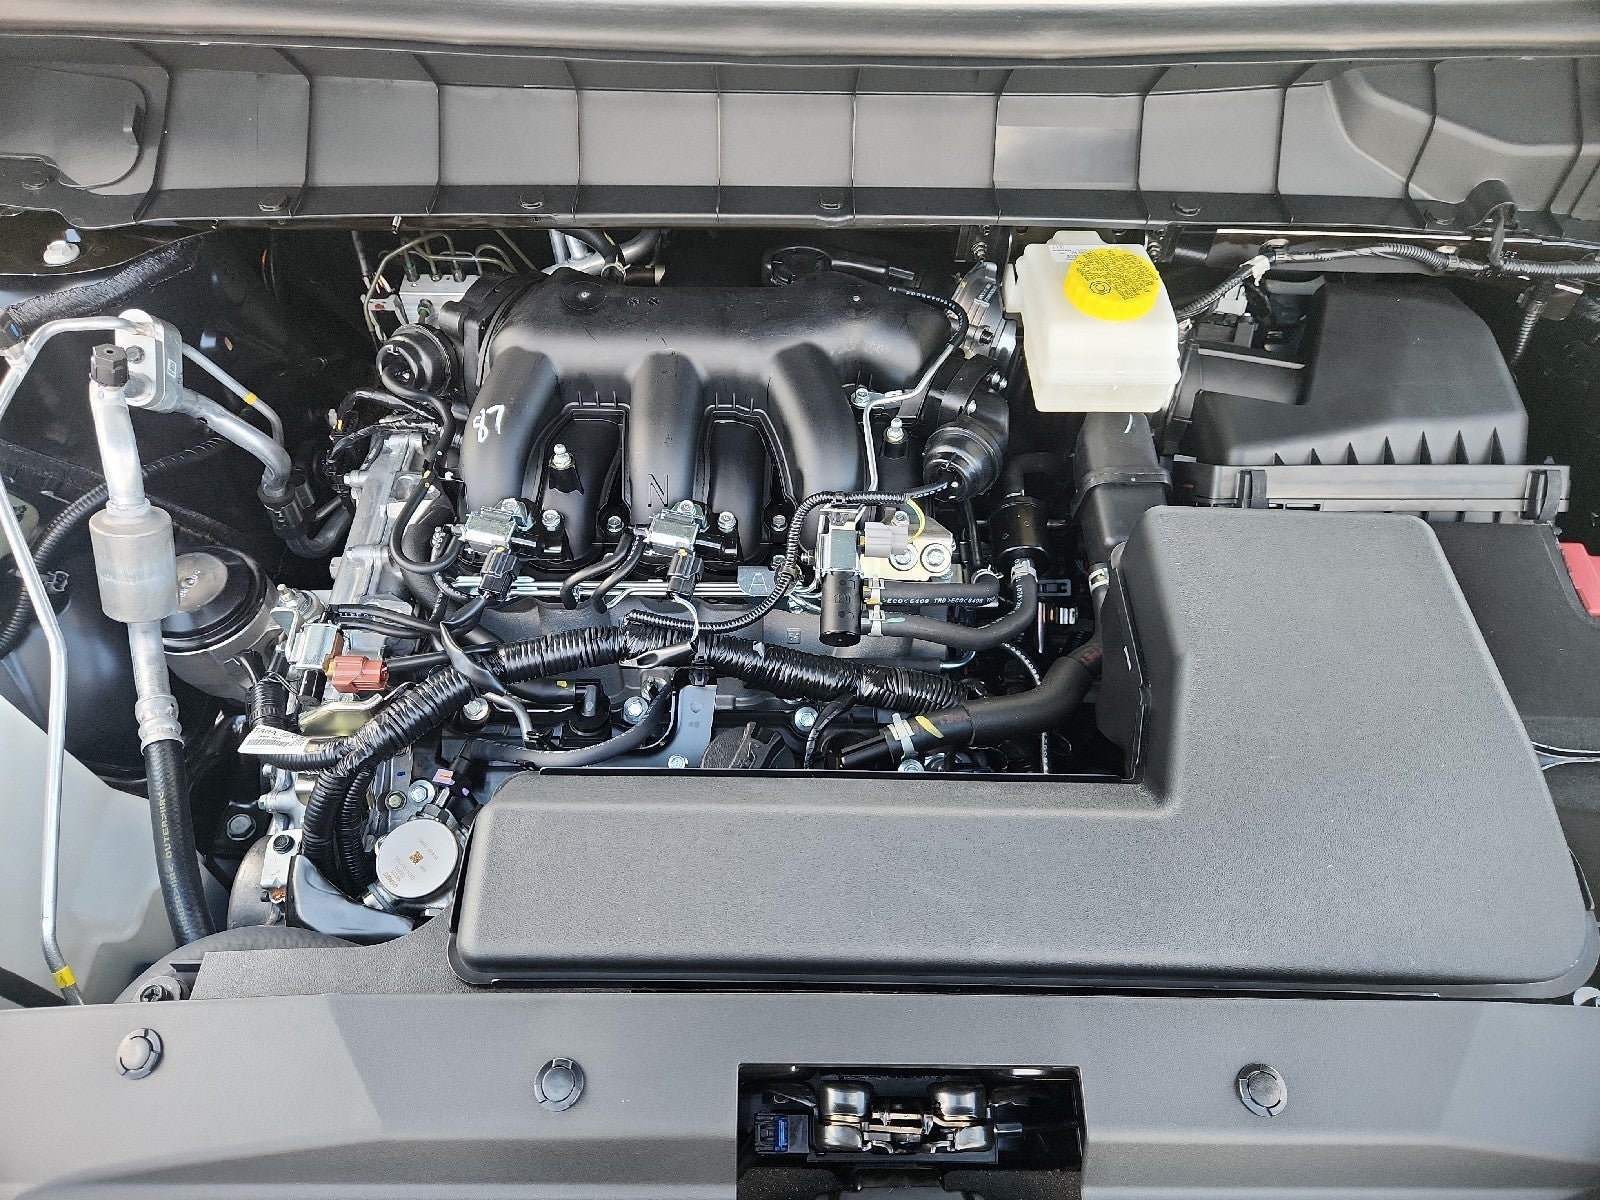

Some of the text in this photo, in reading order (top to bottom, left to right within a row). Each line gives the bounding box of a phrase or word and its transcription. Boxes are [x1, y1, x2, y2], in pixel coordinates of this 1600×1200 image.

[472, 403, 506, 443] 87
[647, 473, 669, 508] N
[748, 572, 768, 593] A
